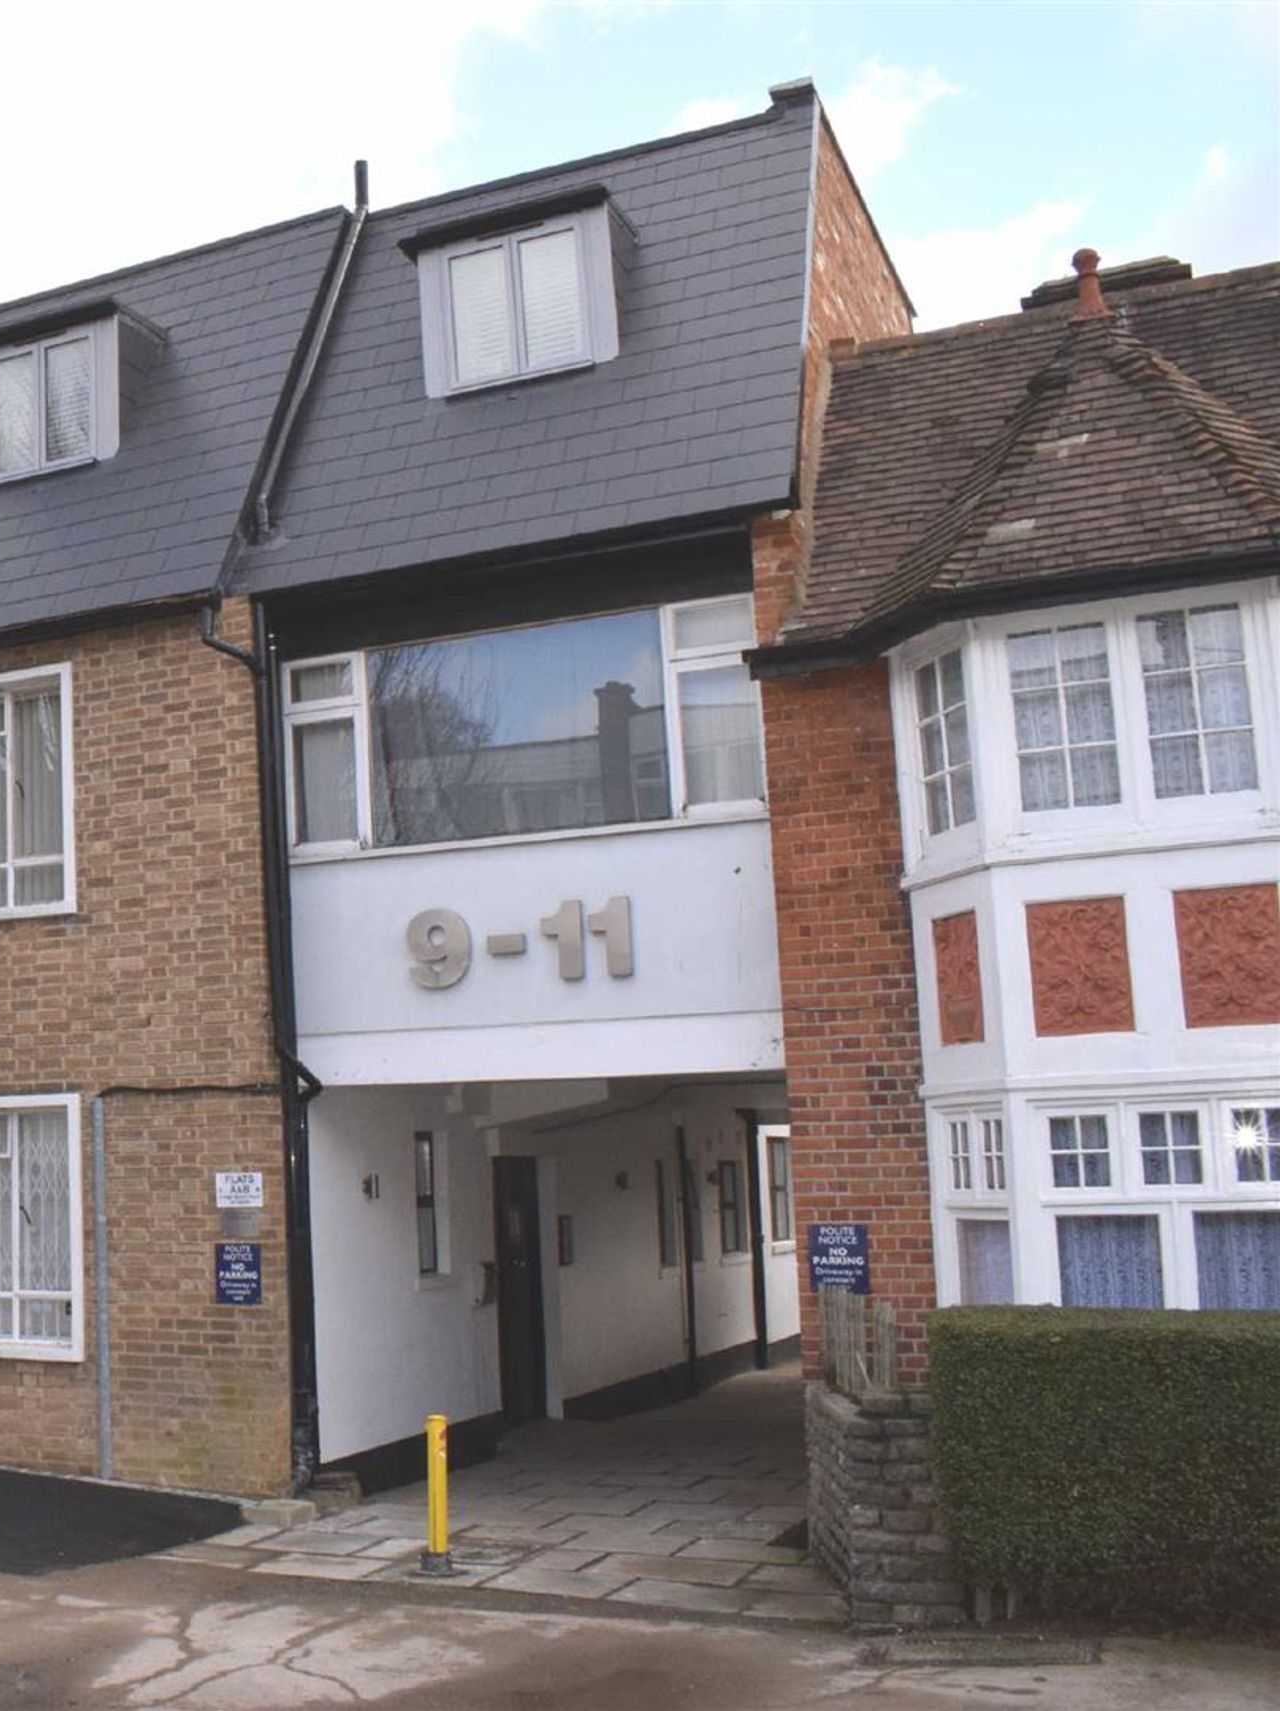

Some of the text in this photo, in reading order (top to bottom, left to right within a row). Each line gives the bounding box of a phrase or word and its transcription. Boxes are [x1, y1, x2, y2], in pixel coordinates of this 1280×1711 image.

[406, 896, 634, 990] 9-11
[224, 1174, 255, 1184] FLATS
[820, 1226, 855, 1236] POLITE
[818, 1235, 858, 1245] NOTICE
[224, 1245, 251, 1253] POLITE
[828, 1247, 848, 1256] NO
[223, 1253, 253, 1262] NOTICE
[812, 1256, 865, 1266] PARKING
[231, 1262, 245, 1271] NO
[219, 1270, 258, 1280] PARKING
